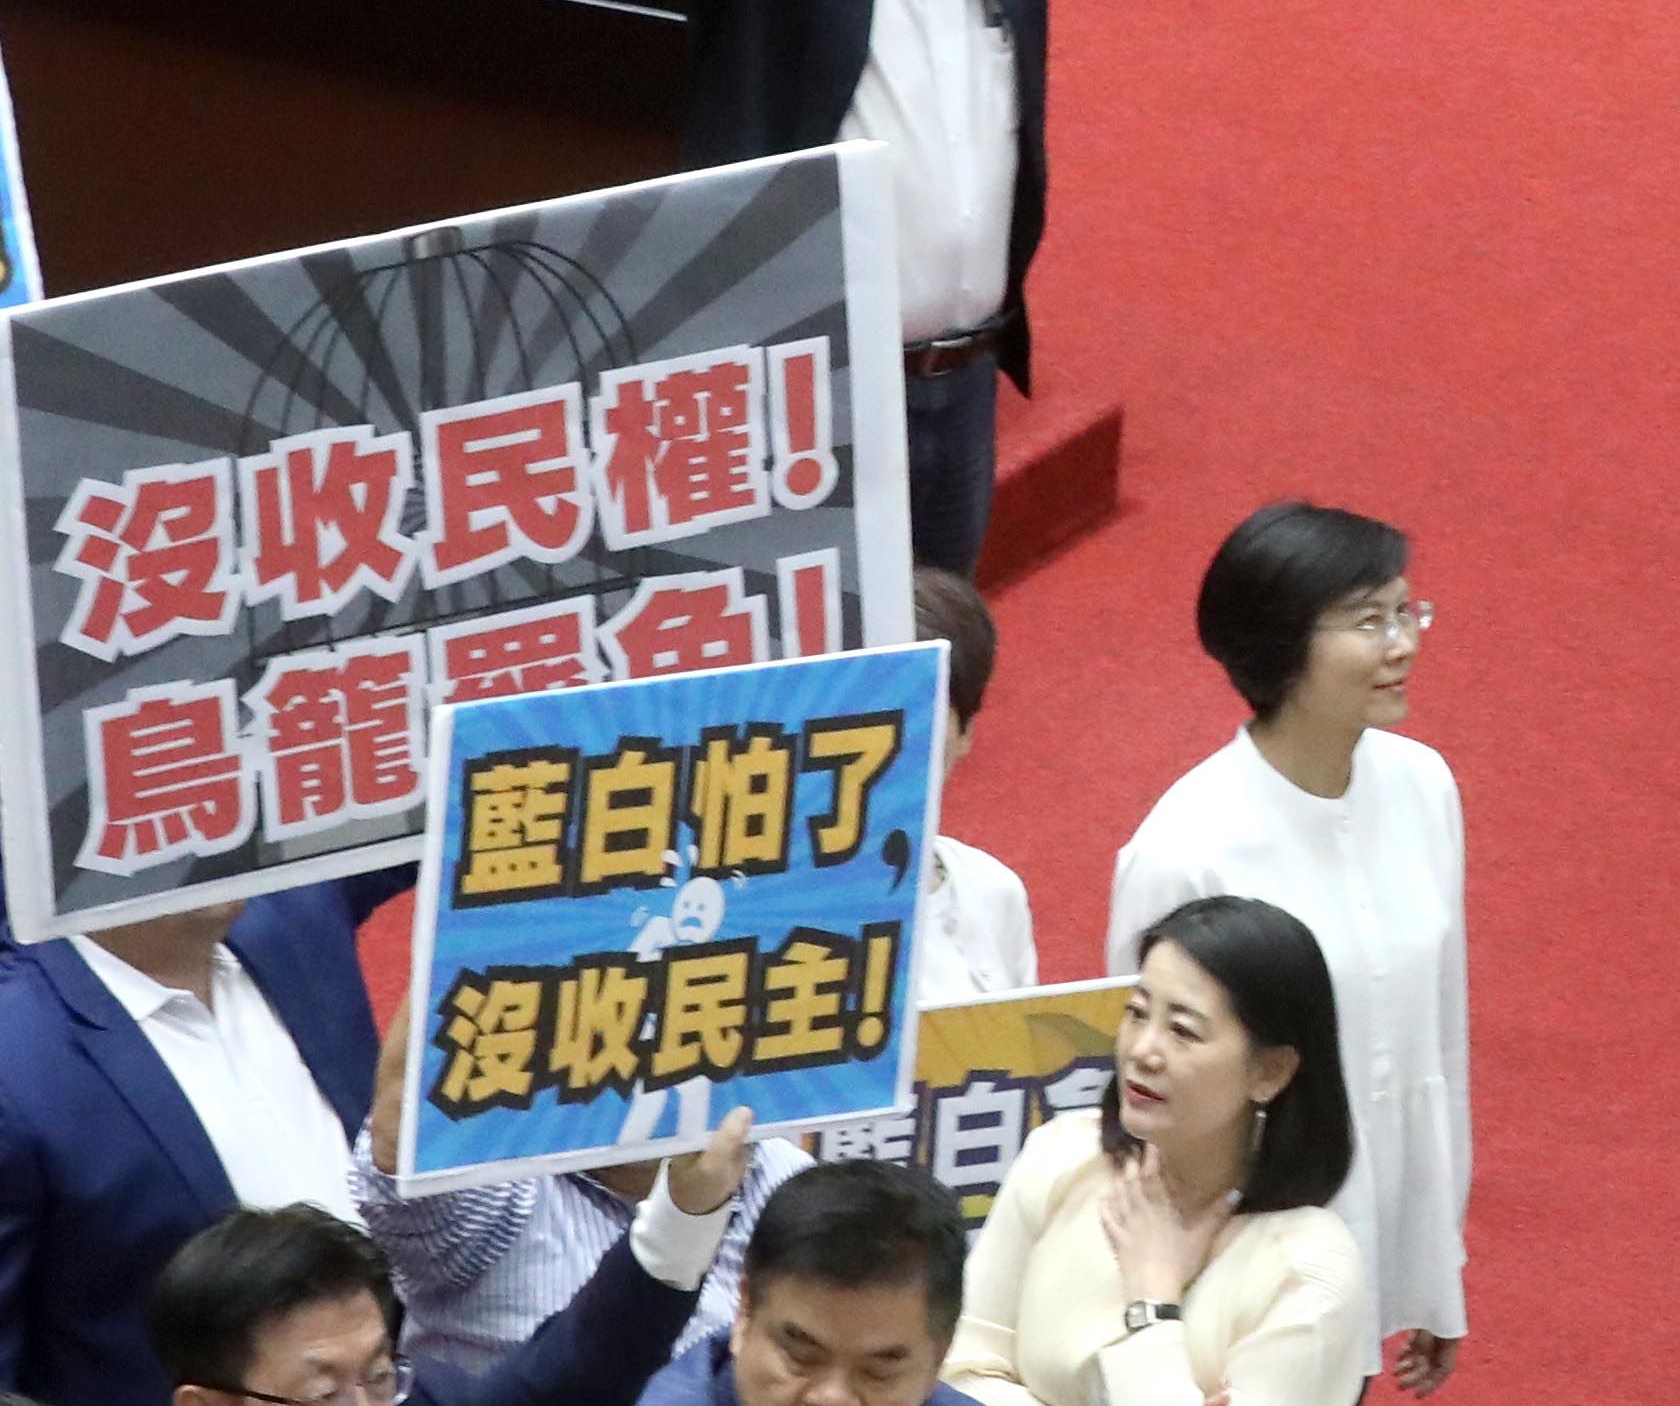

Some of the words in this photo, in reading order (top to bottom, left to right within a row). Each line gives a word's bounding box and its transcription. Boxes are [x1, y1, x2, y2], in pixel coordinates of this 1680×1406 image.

[53, 335, 839, 662] 沒收民權！
[454, 710, 910, 908] 藍白怕了，
[430, 922, 901, 1120] 沒收民主！
